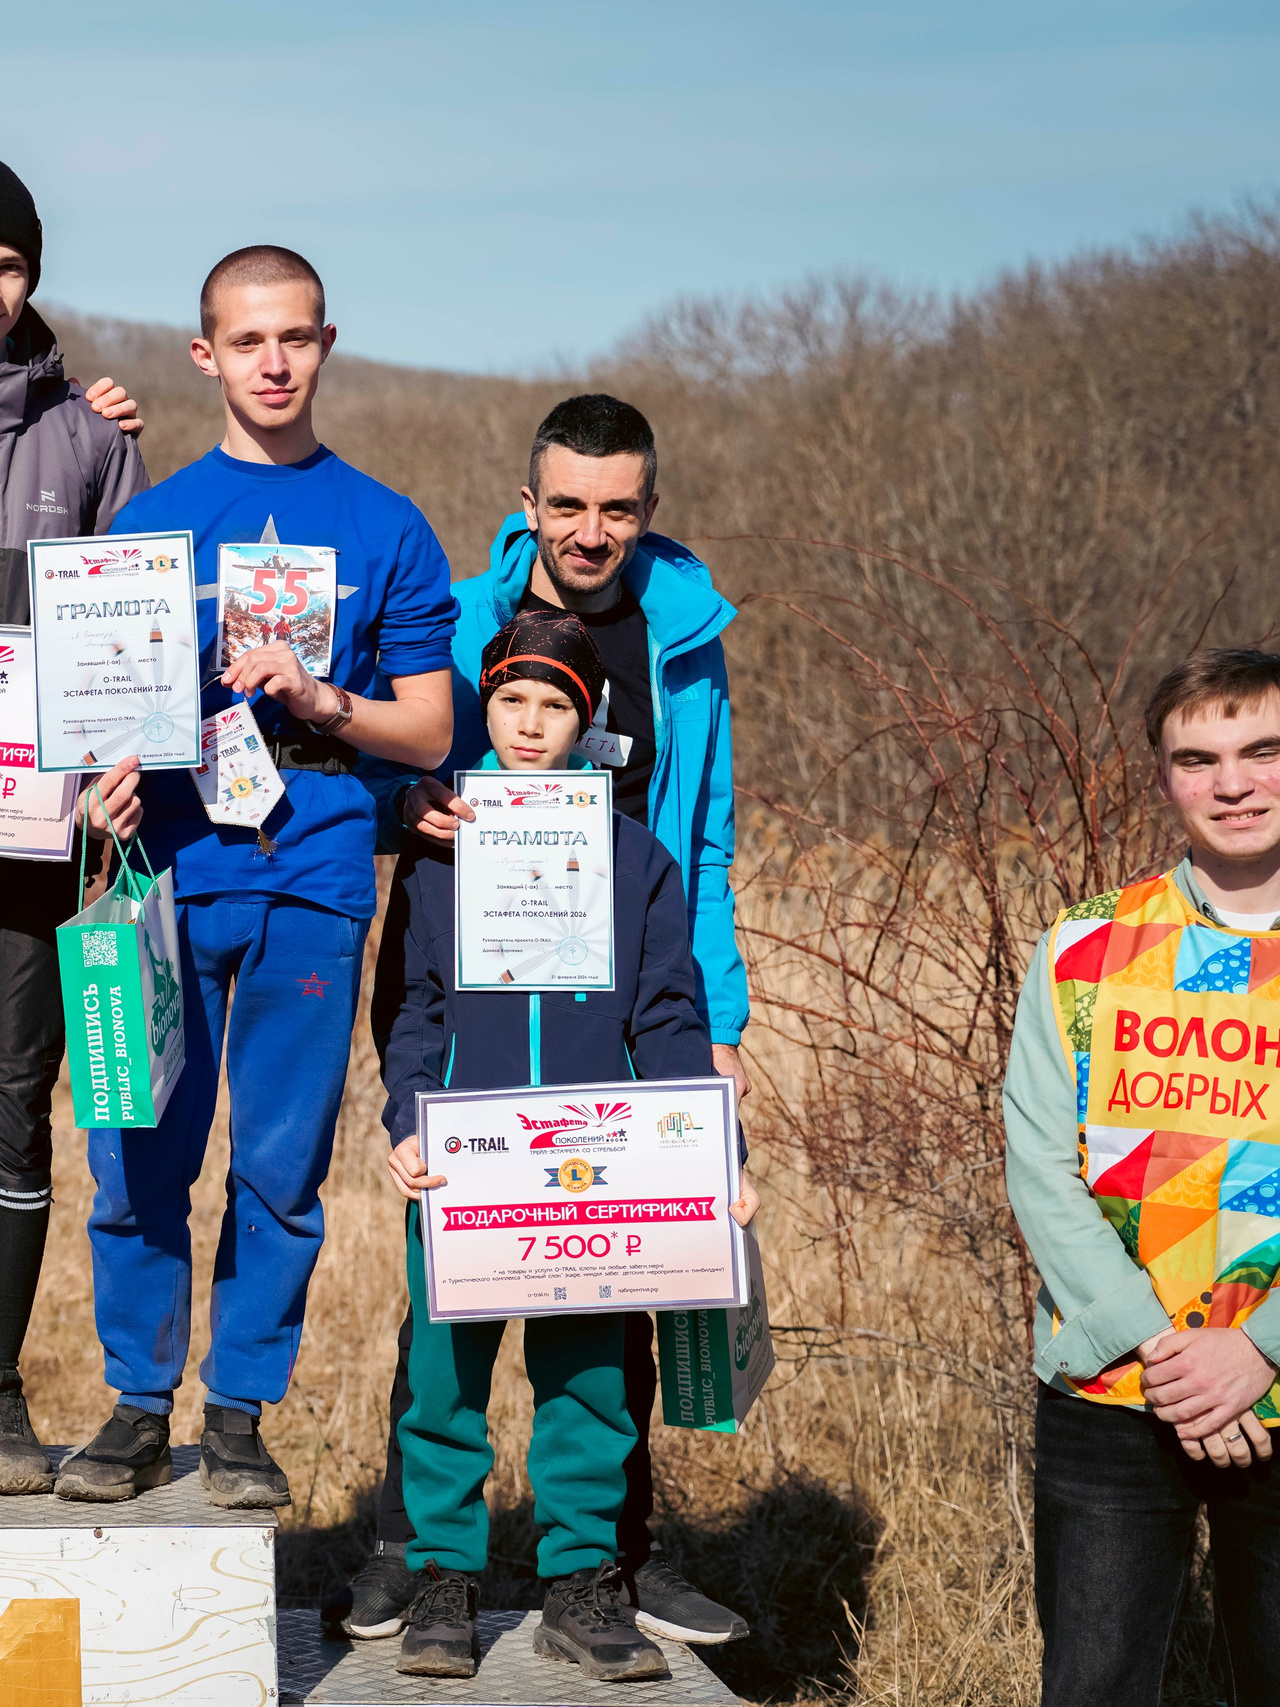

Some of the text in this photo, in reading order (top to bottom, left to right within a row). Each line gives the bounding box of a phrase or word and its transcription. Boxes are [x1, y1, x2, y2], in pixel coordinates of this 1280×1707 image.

[250, 569, 309, 616] 55
[56, 599, 171, 621] ГРАМОТА
[77, 659, 106, 667] Занявший
[103, 675, 132, 683] O-TRAIL
[63, 684, 173, 697] ЭСТАФЕТА ПОКОЛЕНИЙ 2026
[479, 830, 588, 846] ГРАМОТА
[483, 909, 587, 918] ЭСТАФЕТА ПОКОЛЕНИЙ 2026
[151, 990, 180, 1046] bionova
[1114, 1009, 1280, 1068] ВОЛОН
[83, 983, 110, 1122] ПОДПИШИСЬ
[109, 985, 134, 1121] PUBLIC_BIONOVA
[1107, 1068, 1270, 1120] ДОБРЫХ
[516, 1113, 588, 1130] Эстафета
[444, 1136, 509, 1154] O-TRAIL
[555, 1134, 605, 1144] ПОКОЛЕНИЙ
[571, 1169, 582, 1182] L
[450, 1201, 711, 1227] ПОДАРОЧНЫЙ СЕРТИФИКАТ
[517, 1236, 538, 1261] 7
[448, 1277, 491, 1285] Туристического
[646, 1268, 683, 1276] мероприятия
[734, 1306, 763, 1362] bionova
